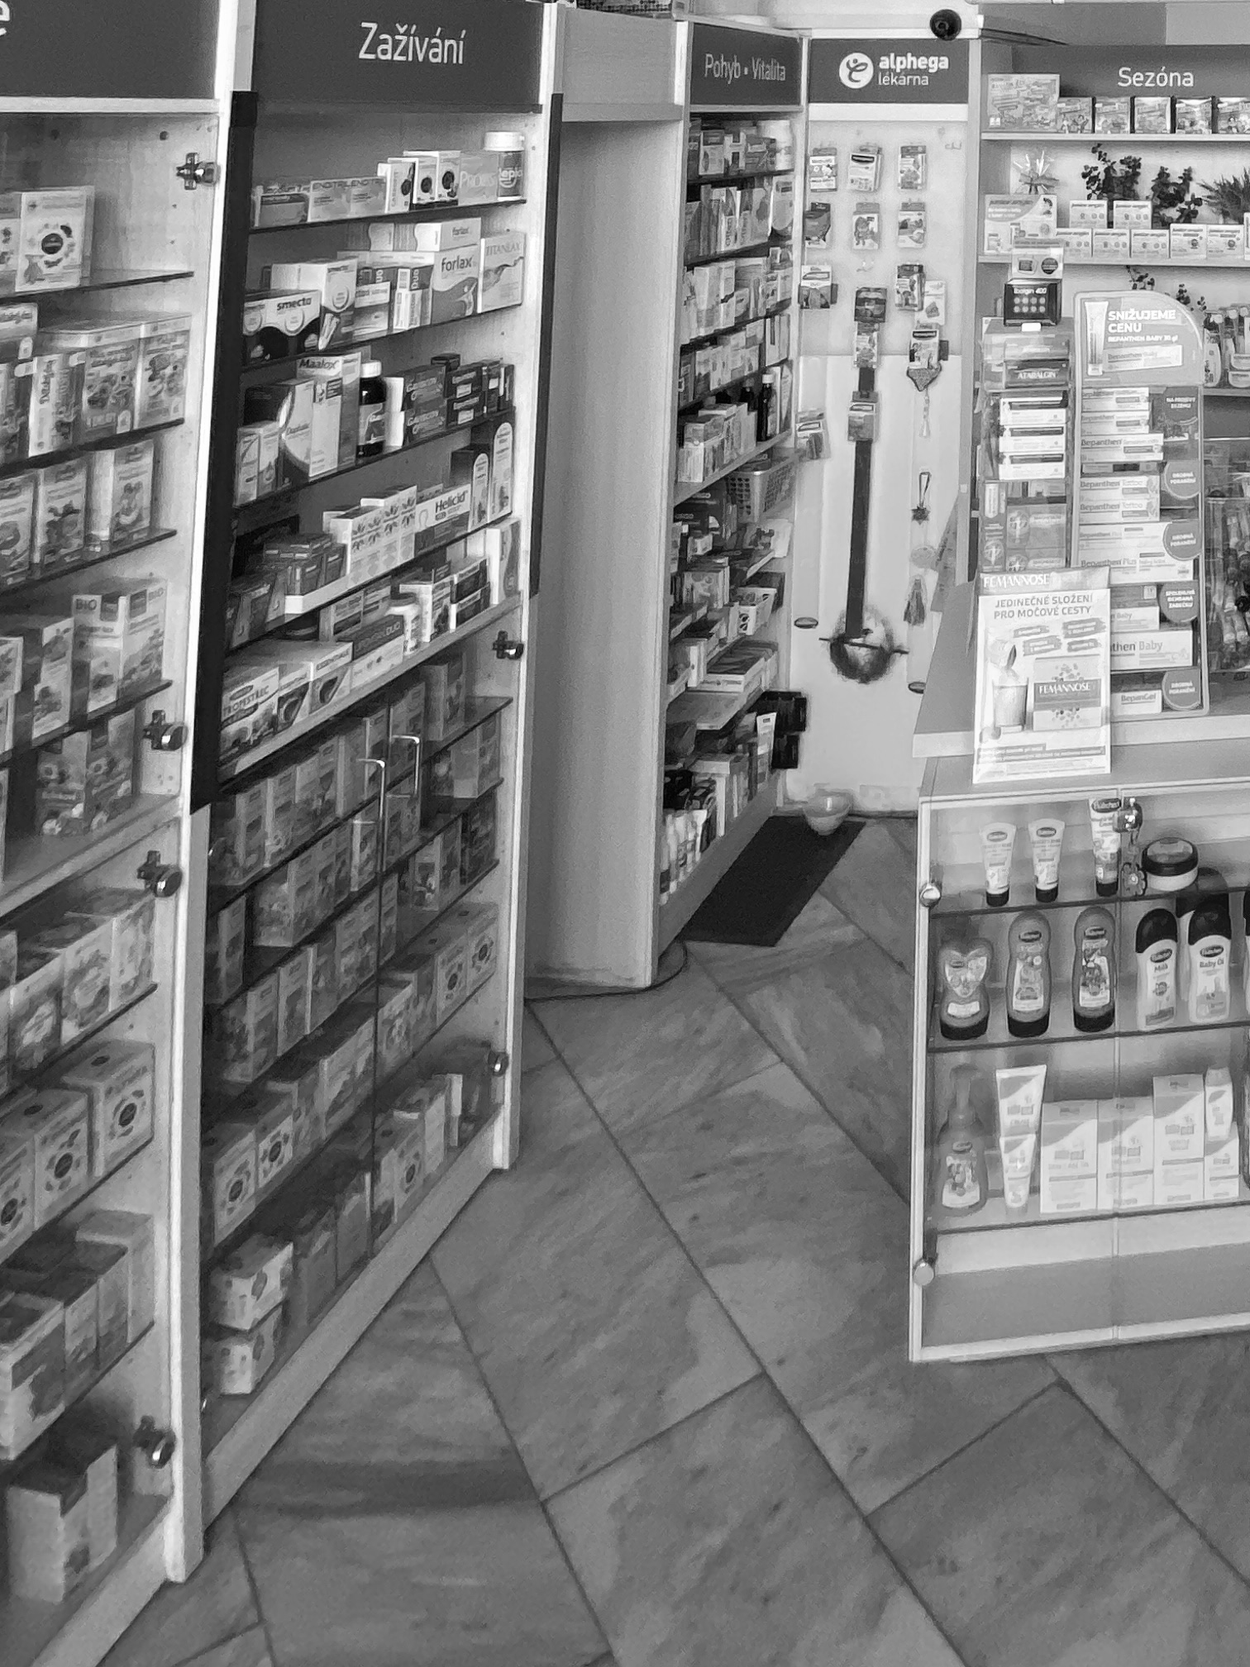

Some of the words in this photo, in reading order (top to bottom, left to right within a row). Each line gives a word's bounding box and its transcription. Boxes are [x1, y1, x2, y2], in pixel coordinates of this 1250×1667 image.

[359, 21, 465, 65] Zažívání
[705, 53, 741, 84] Pohyb
[752, 57, 786, 81] Vitalita
[878, 52, 949, 73] alphega
[878, 73, 929, 86] lékárna
[1117, 66, 1195, 88] Sezóna
[441, 255, 474, 273] forlax
[276, 297, 312, 311] smecta
[1107, 308, 1176, 321] SNIŽUJEME
[1107, 323, 1142, 333] CENU
[299, 358, 339, 371] Maalox
[435, 490, 467, 512] Helicid
[75, 599, 97, 611] BIO
[995, 594, 1050, 608] JEDINEČNÉ
[1052, 594, 1093, 604] SLOŽENÍ
[994, 609, 1015, 620] PRO
[1018, 606, 1060, 618] MOČOVÉ
[1062, 606, 1092, 616] CESTY
[1139, 641, 1163, 652] Baby
